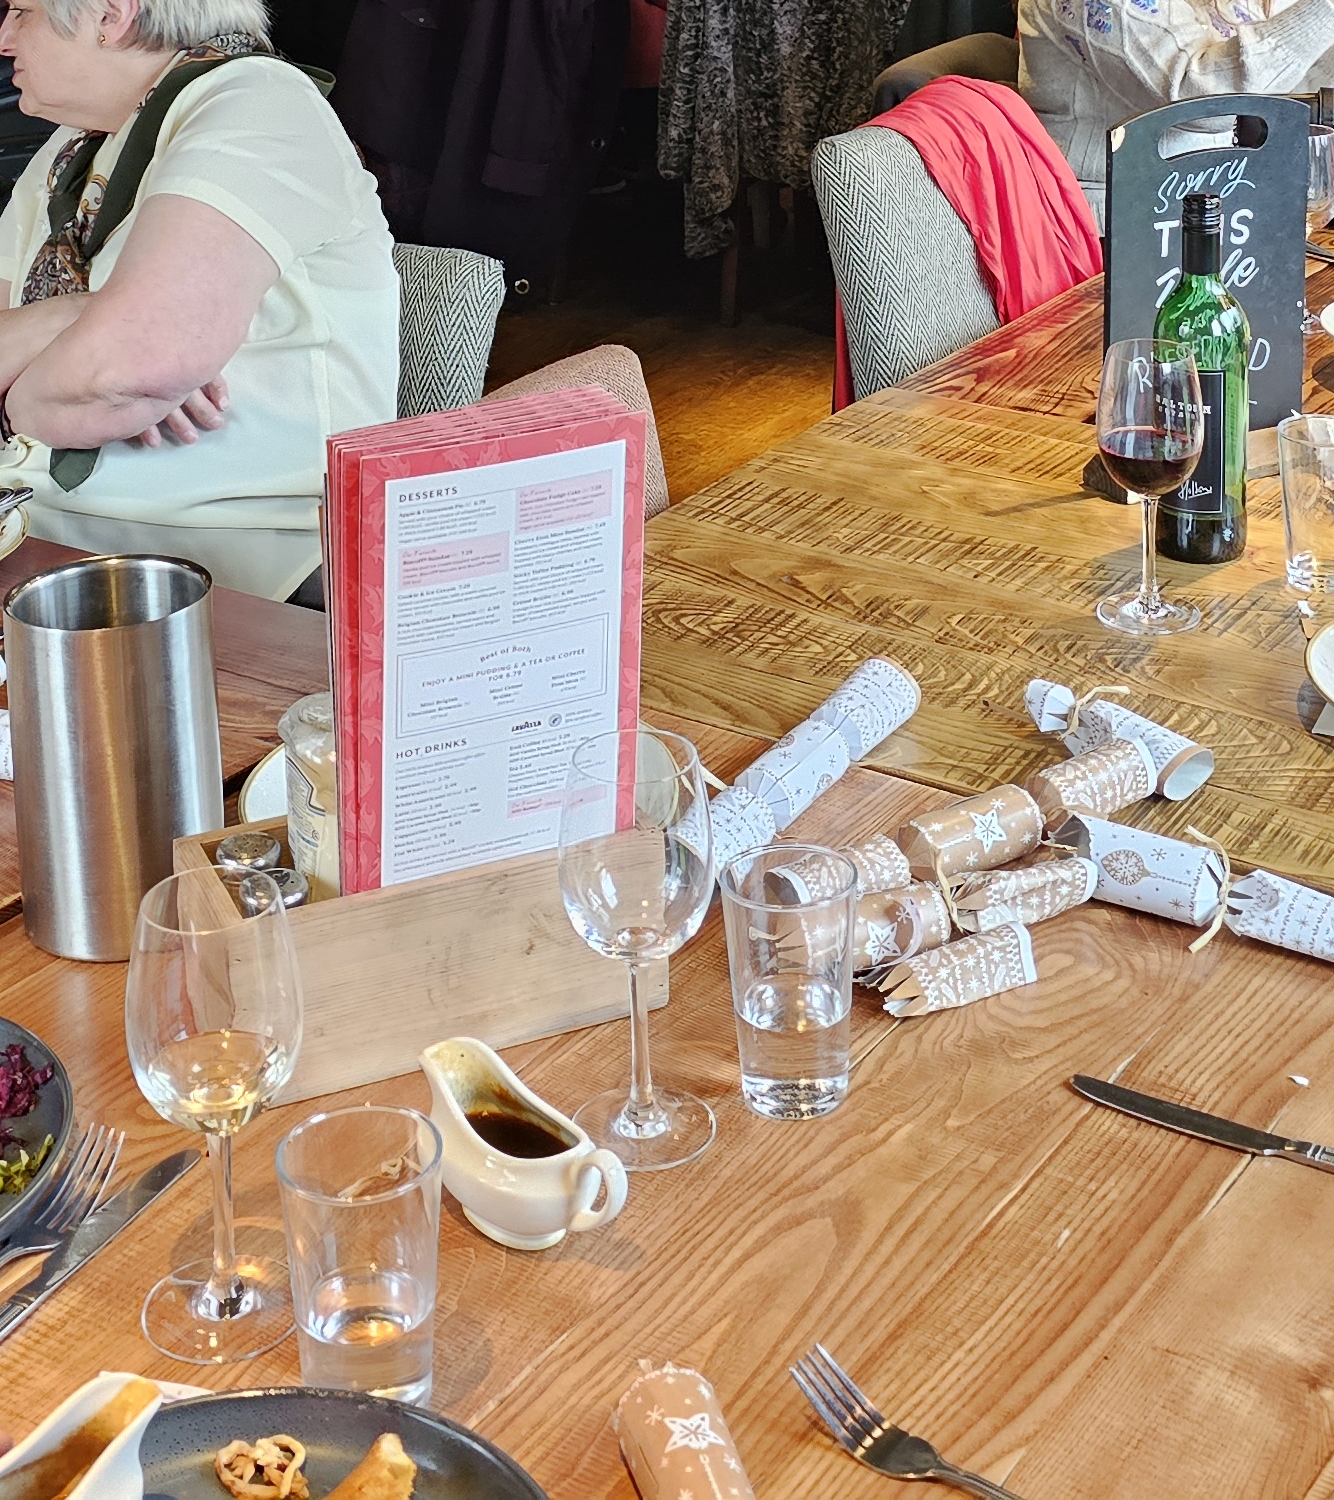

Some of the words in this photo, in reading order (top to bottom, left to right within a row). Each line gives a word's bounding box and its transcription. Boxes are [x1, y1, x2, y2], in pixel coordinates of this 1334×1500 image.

[1153, 156, 1256, 214] Sorry
[399, 485, 458, 503] DESSERTS
[395, 746, 420, 760] HOT
[424, 737, 467, 754] DRINKS
